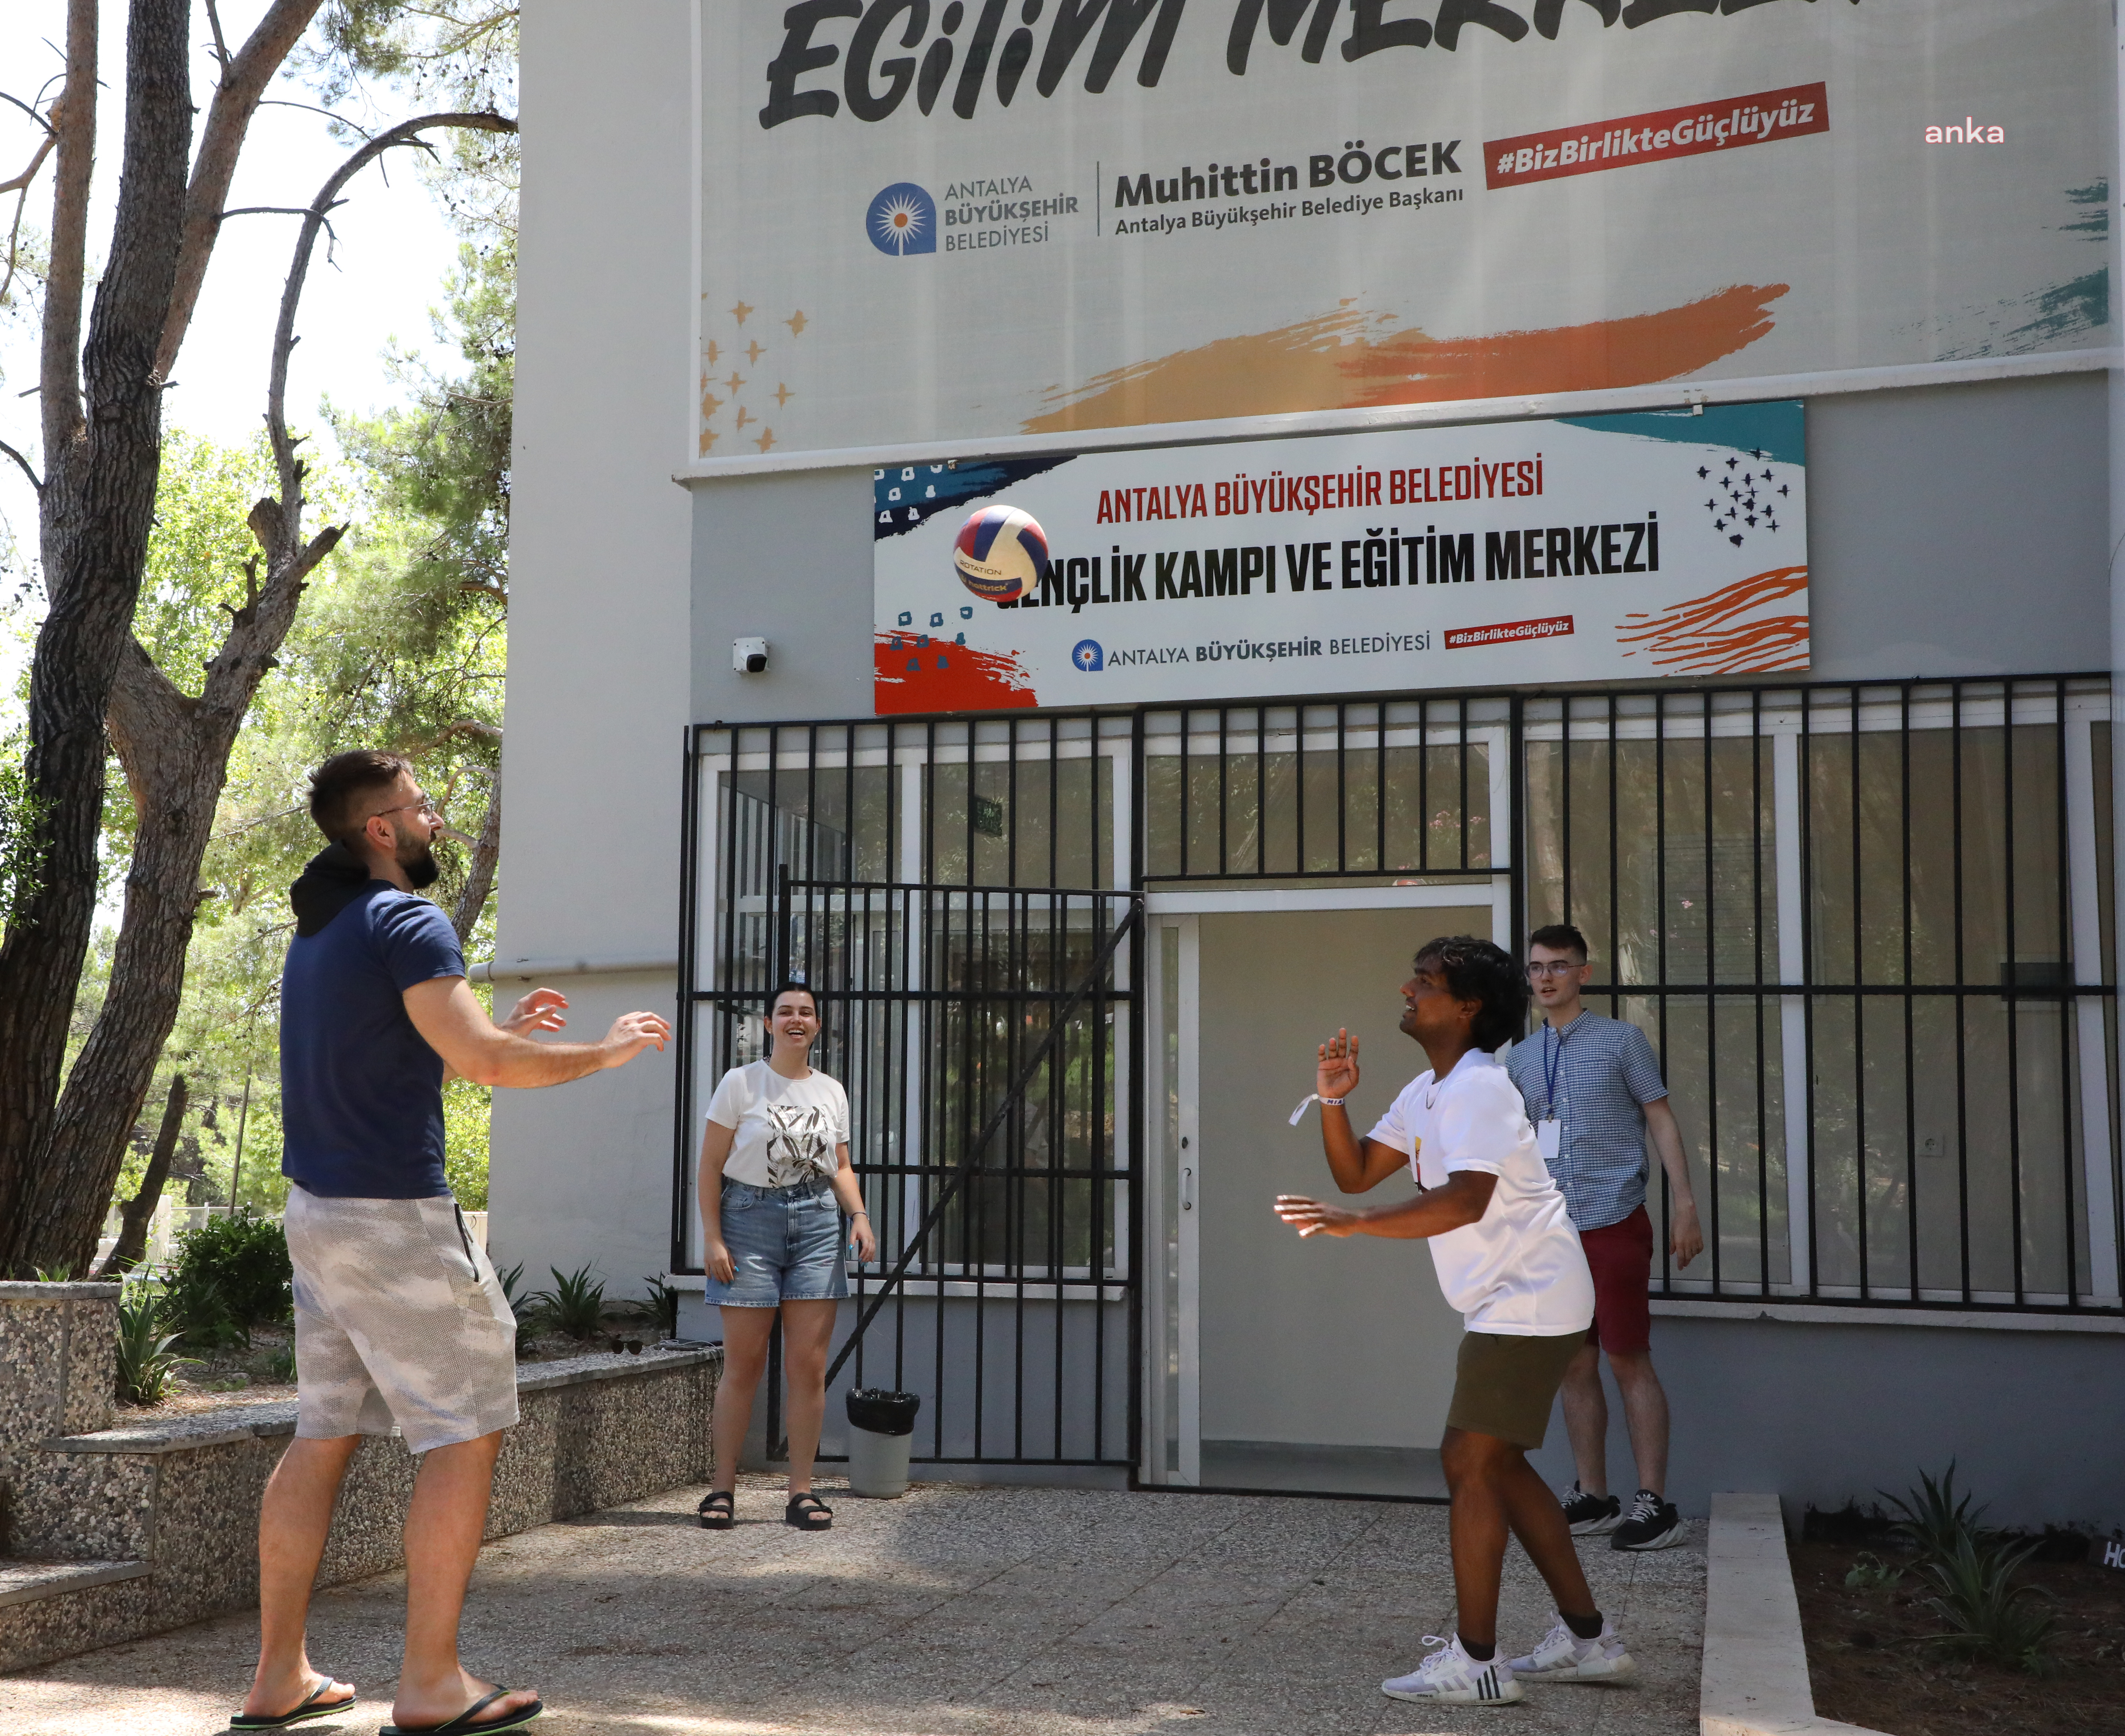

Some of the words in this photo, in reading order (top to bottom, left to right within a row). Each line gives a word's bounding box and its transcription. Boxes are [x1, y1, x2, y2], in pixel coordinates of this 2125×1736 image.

[1496, 99, 1815, 174] #BizBirlikteGüçlüyüz
[945, 176, 1033, 200] ANTALYA
[1115, 158, 1298, 208] Muhittin
[1309, 140, 1462, 188] BÖCEK
[945, 193, 1079, 226] BÜYÜKŞEHİR
[1115, 214, 1186, 235] Antalya
[1192, 202, 1297, 230] Büyükşehir
[1302, 195, 1383, 216] Belediye
[1390, 187, 1463, 210] Başkanı
[946, 220, 1048, 251] BELEDİYESİ
[1097, 484, 1207, 524] ANTALYA
[1215, 465, 1382, 516] BÜYÜKŞEHİR
[1390, 453, 1542, 505] BELEDİYESİ
[960, 560, 1002, 575] ROTATION
[997, 545, 1147, 614] NÇLİK
[1155, 545, 1276, 600] KAMPI
[1285, 542, 1332, 592] VE
[1341, 525, 1474, 589] EĞİTİM
[1485, 511, 1659, 581] MERKEZİ
[1108, 647, 1190, 666] ANTALYA
[1196, 636, 1323, 662] BÜYÜKŞEHİR
[1330, 630, 1430, 654] BELEDİYESİ
[1449, 621, 1569, 644] #BizBirlikteGüçlüyüz
